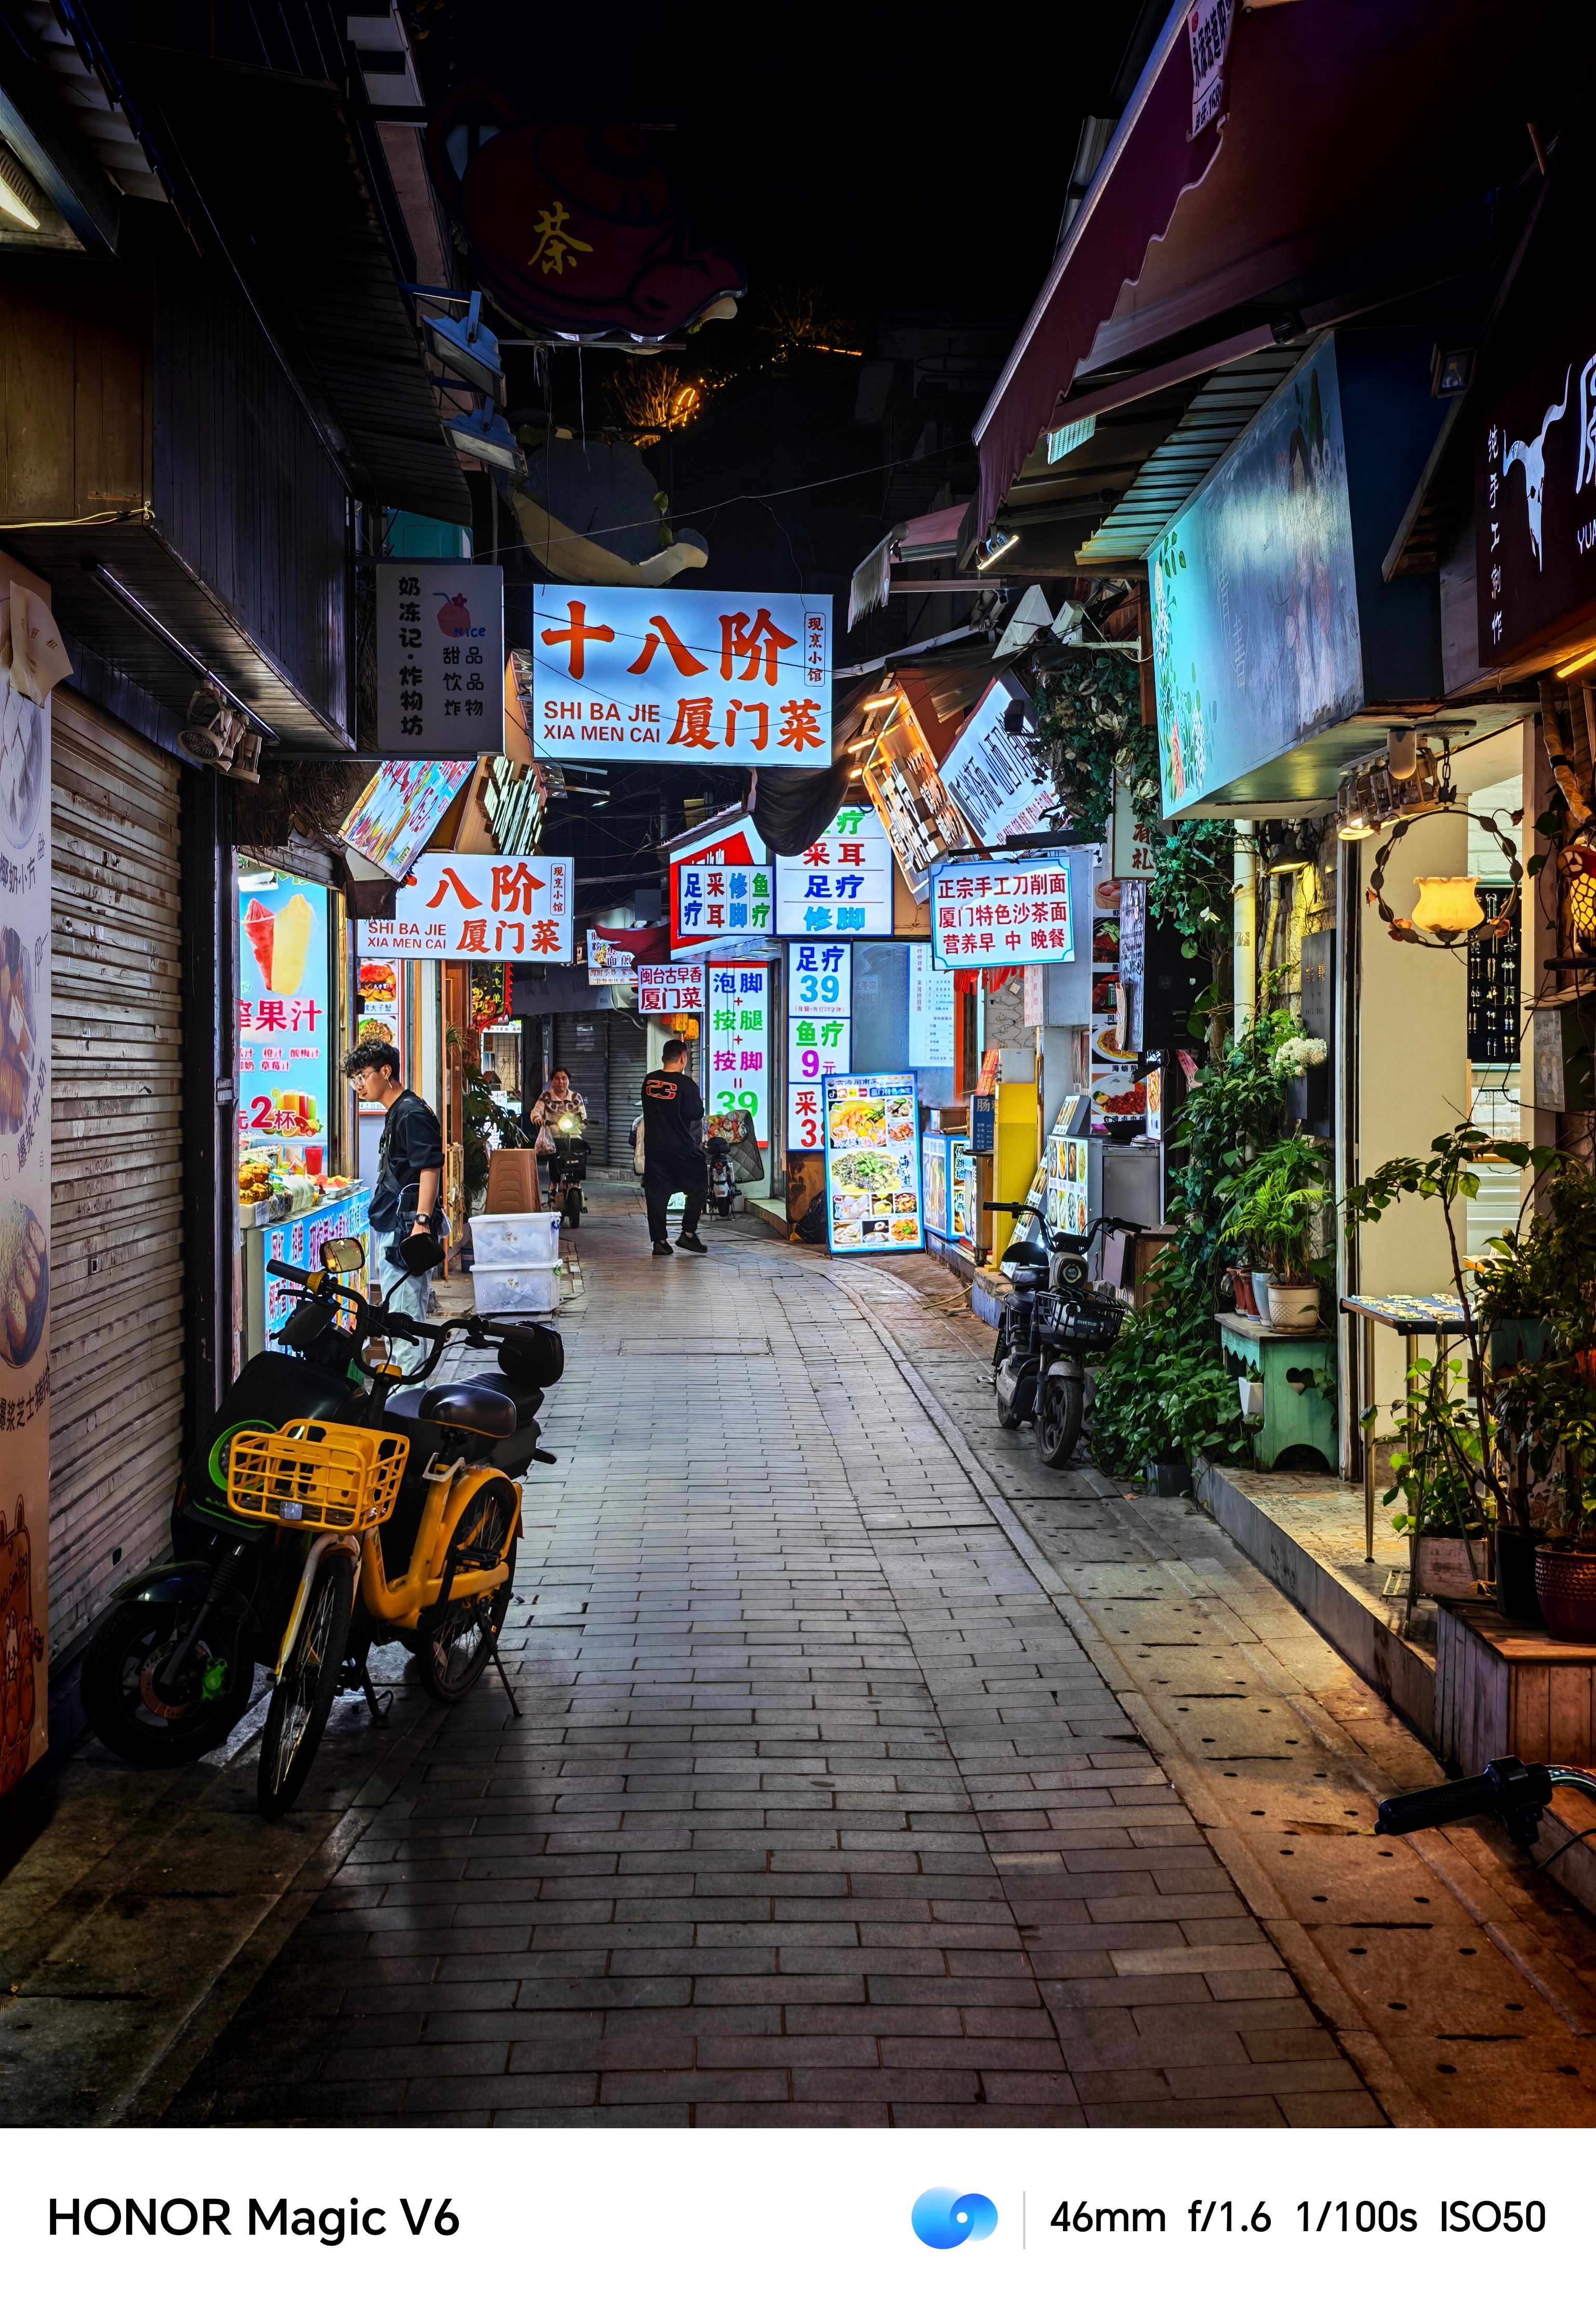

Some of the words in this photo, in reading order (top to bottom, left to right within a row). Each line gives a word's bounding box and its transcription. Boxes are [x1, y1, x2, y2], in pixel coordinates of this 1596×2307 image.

[528, 201, 593, 275] 茶
[1488, 424, 1502, 645] 纯手工制作
[443, 646, 483, 665] 甜品
[541, 600, 798, 687] 十八阶
[807, 616, 824, 683] 现烹小馆
[443, 672, 484, 691] 饮品
[444, 699, 484, 717] 炸物
[543, 700, 581, 720] SHI
[590, 702, 621, 721] BA
[628, 704, 660, 723] JIE
[543, 724, 576, 740] XIA
[580, 726, 624, 741] MEN
[629, 727, 660, 743] CAI
[666, 696, 826, 752] 厦门菜
[822, 810, 866, 835] 疗
[803, 842, 866, 867] 采耳
[552, 866, 564, 913] 现烹小馆
[684, 872, 703, 926] 足疗
[804, 874, 864, 899] 足疗
[938, 873, 1066, 899] 正宗手工刀削面
[707, 872, 725, 929] 采耳
[729, 872, 747, 929] 修脚
[751, 872, 770, 929] 鱼疗
[803, 906, 866, 932] 修脚
[939, 901, 1067, 928] 厦门特色沙茶面
[368, 922, 394, 935] SHI
[398, 923, 420, 935] BA
[424, 924, 446, 936] JIE
[456, 919, 563, 954] 厦门菜
[943, 932, 996, 955] 营养早
[1005, 931, 1021, 951] 中
[1030, 929, 1065, 950] 晚餐
[367, 937, 389, 947] XIA
[393, 938, 422, 949] MEN
[425, 939, 446, 949] CAI
[796, 946, 845, 973] 足疗
[640, 966, 702, 985] 闽台古早香
[713, 973, 763, 993] 泡脚
[640, 987, 702, 1011] 厦门菜
[800, 975, 840, 1003] 39
[713, 1010, 763, 1031] 按腿
[795, 1020, 844, 1048] 鱼疗
[713, 1050, 763, 1071] 按脚
[646, 1080, 677, 1099] 23
[716, 1091, 758, 1118] 39
